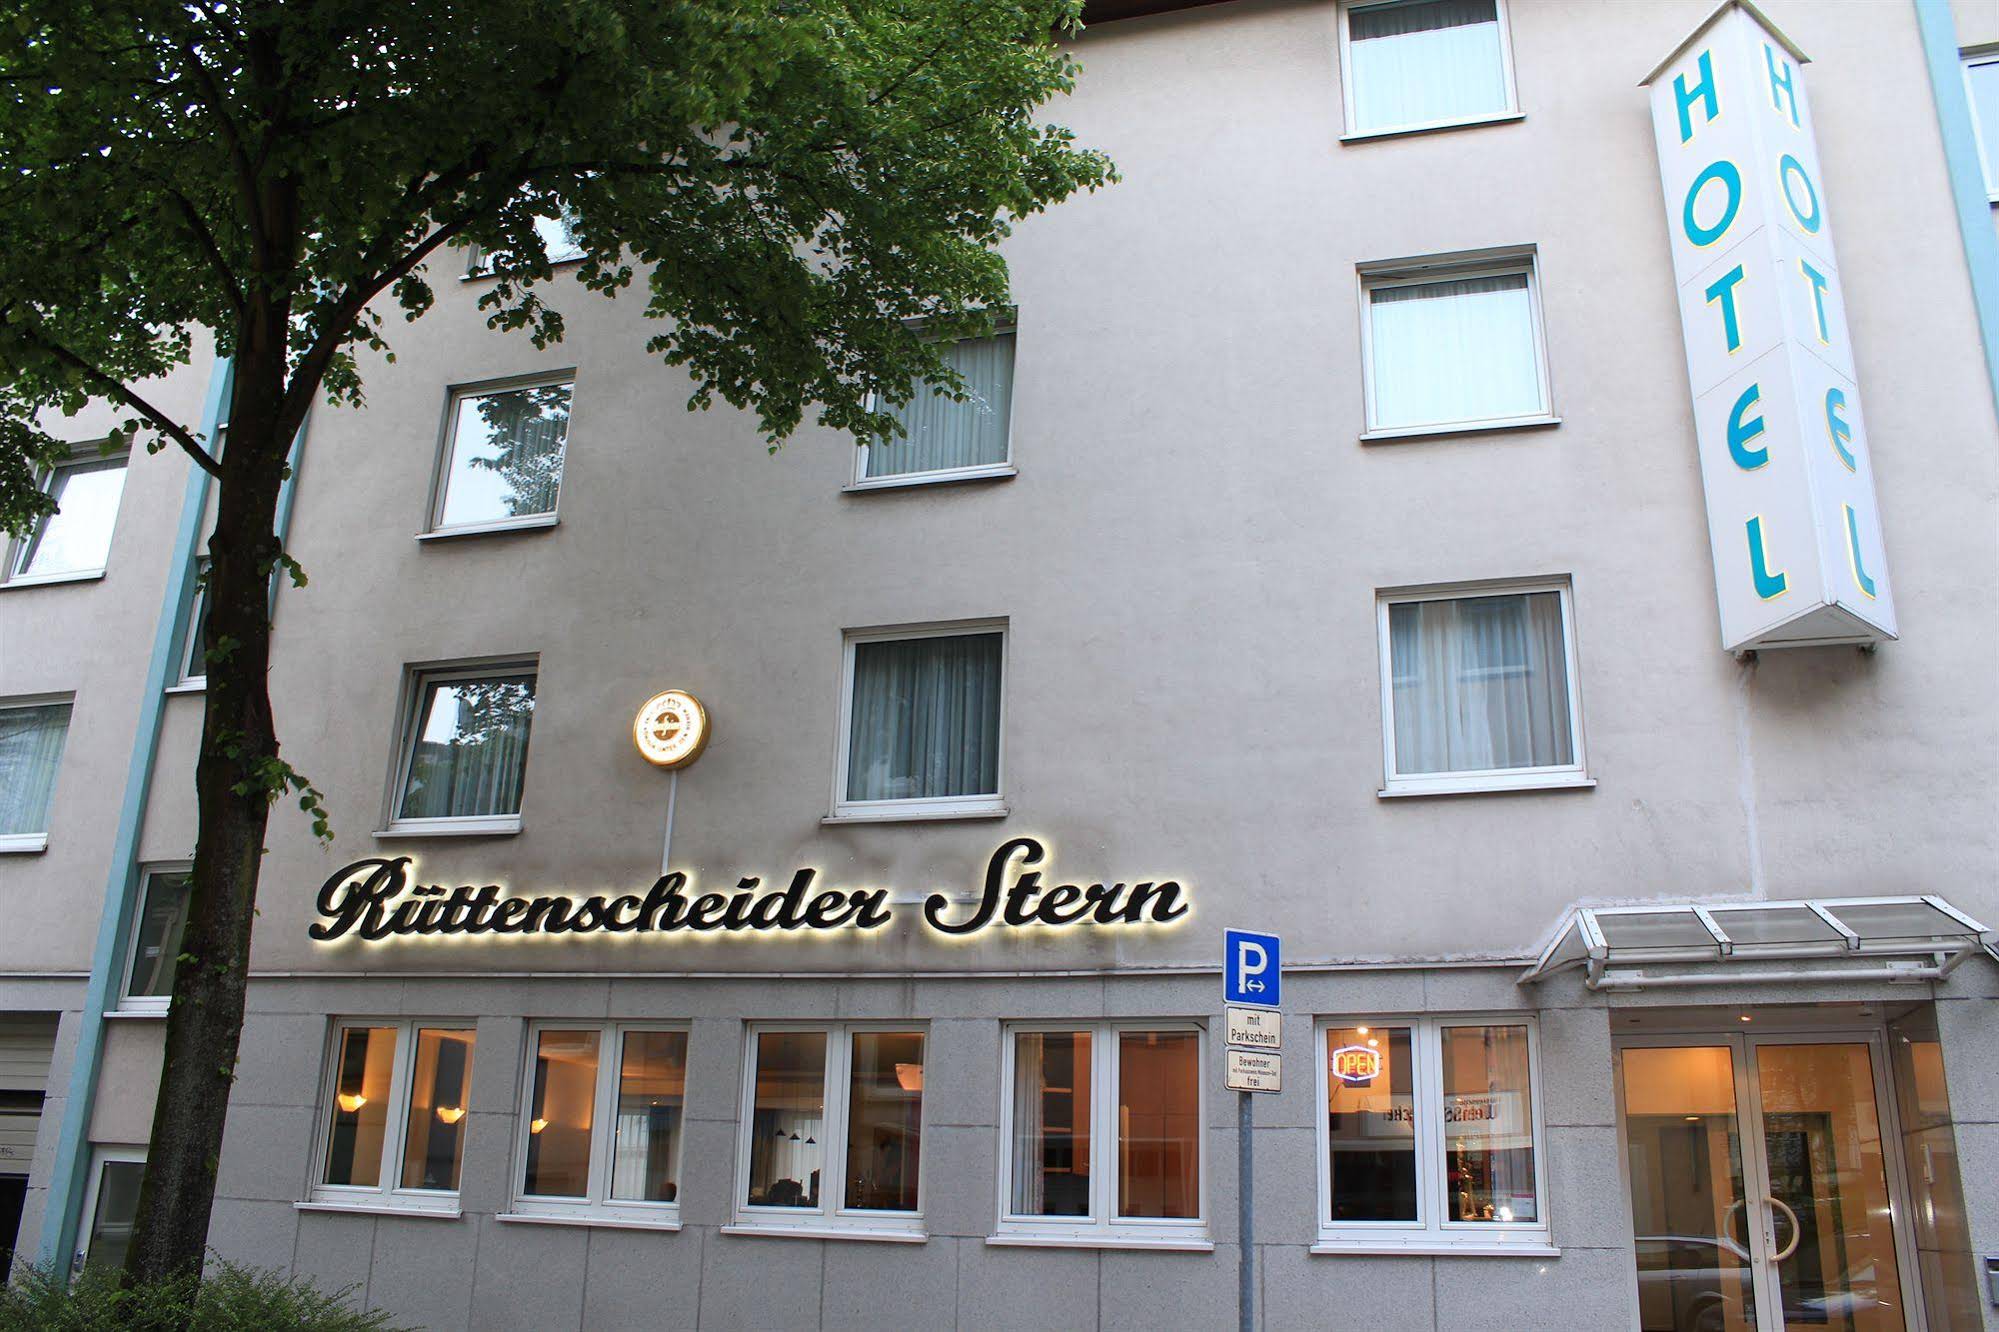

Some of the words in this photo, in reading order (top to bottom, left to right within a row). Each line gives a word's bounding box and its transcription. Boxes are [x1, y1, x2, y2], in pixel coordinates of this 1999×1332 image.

[1671, 47, 1789, 602] HOTEL
[1762, 41, 1877, 601] HOTEL
[308, 856, 892, 941] Rüttenscheider
[924, 837, 1189, 935] Stern
[1238, 940, 1268, 994] P
[1246, 1014, 1261, 1026] mit
[1231, 1028, 1276, 1044] Parkschein
[1238, 1055, 1271, 1068] Bewohner
[1335, 1053, 1376, 1076] OPEN
[1246, 1075, 1260, 1087] frei
